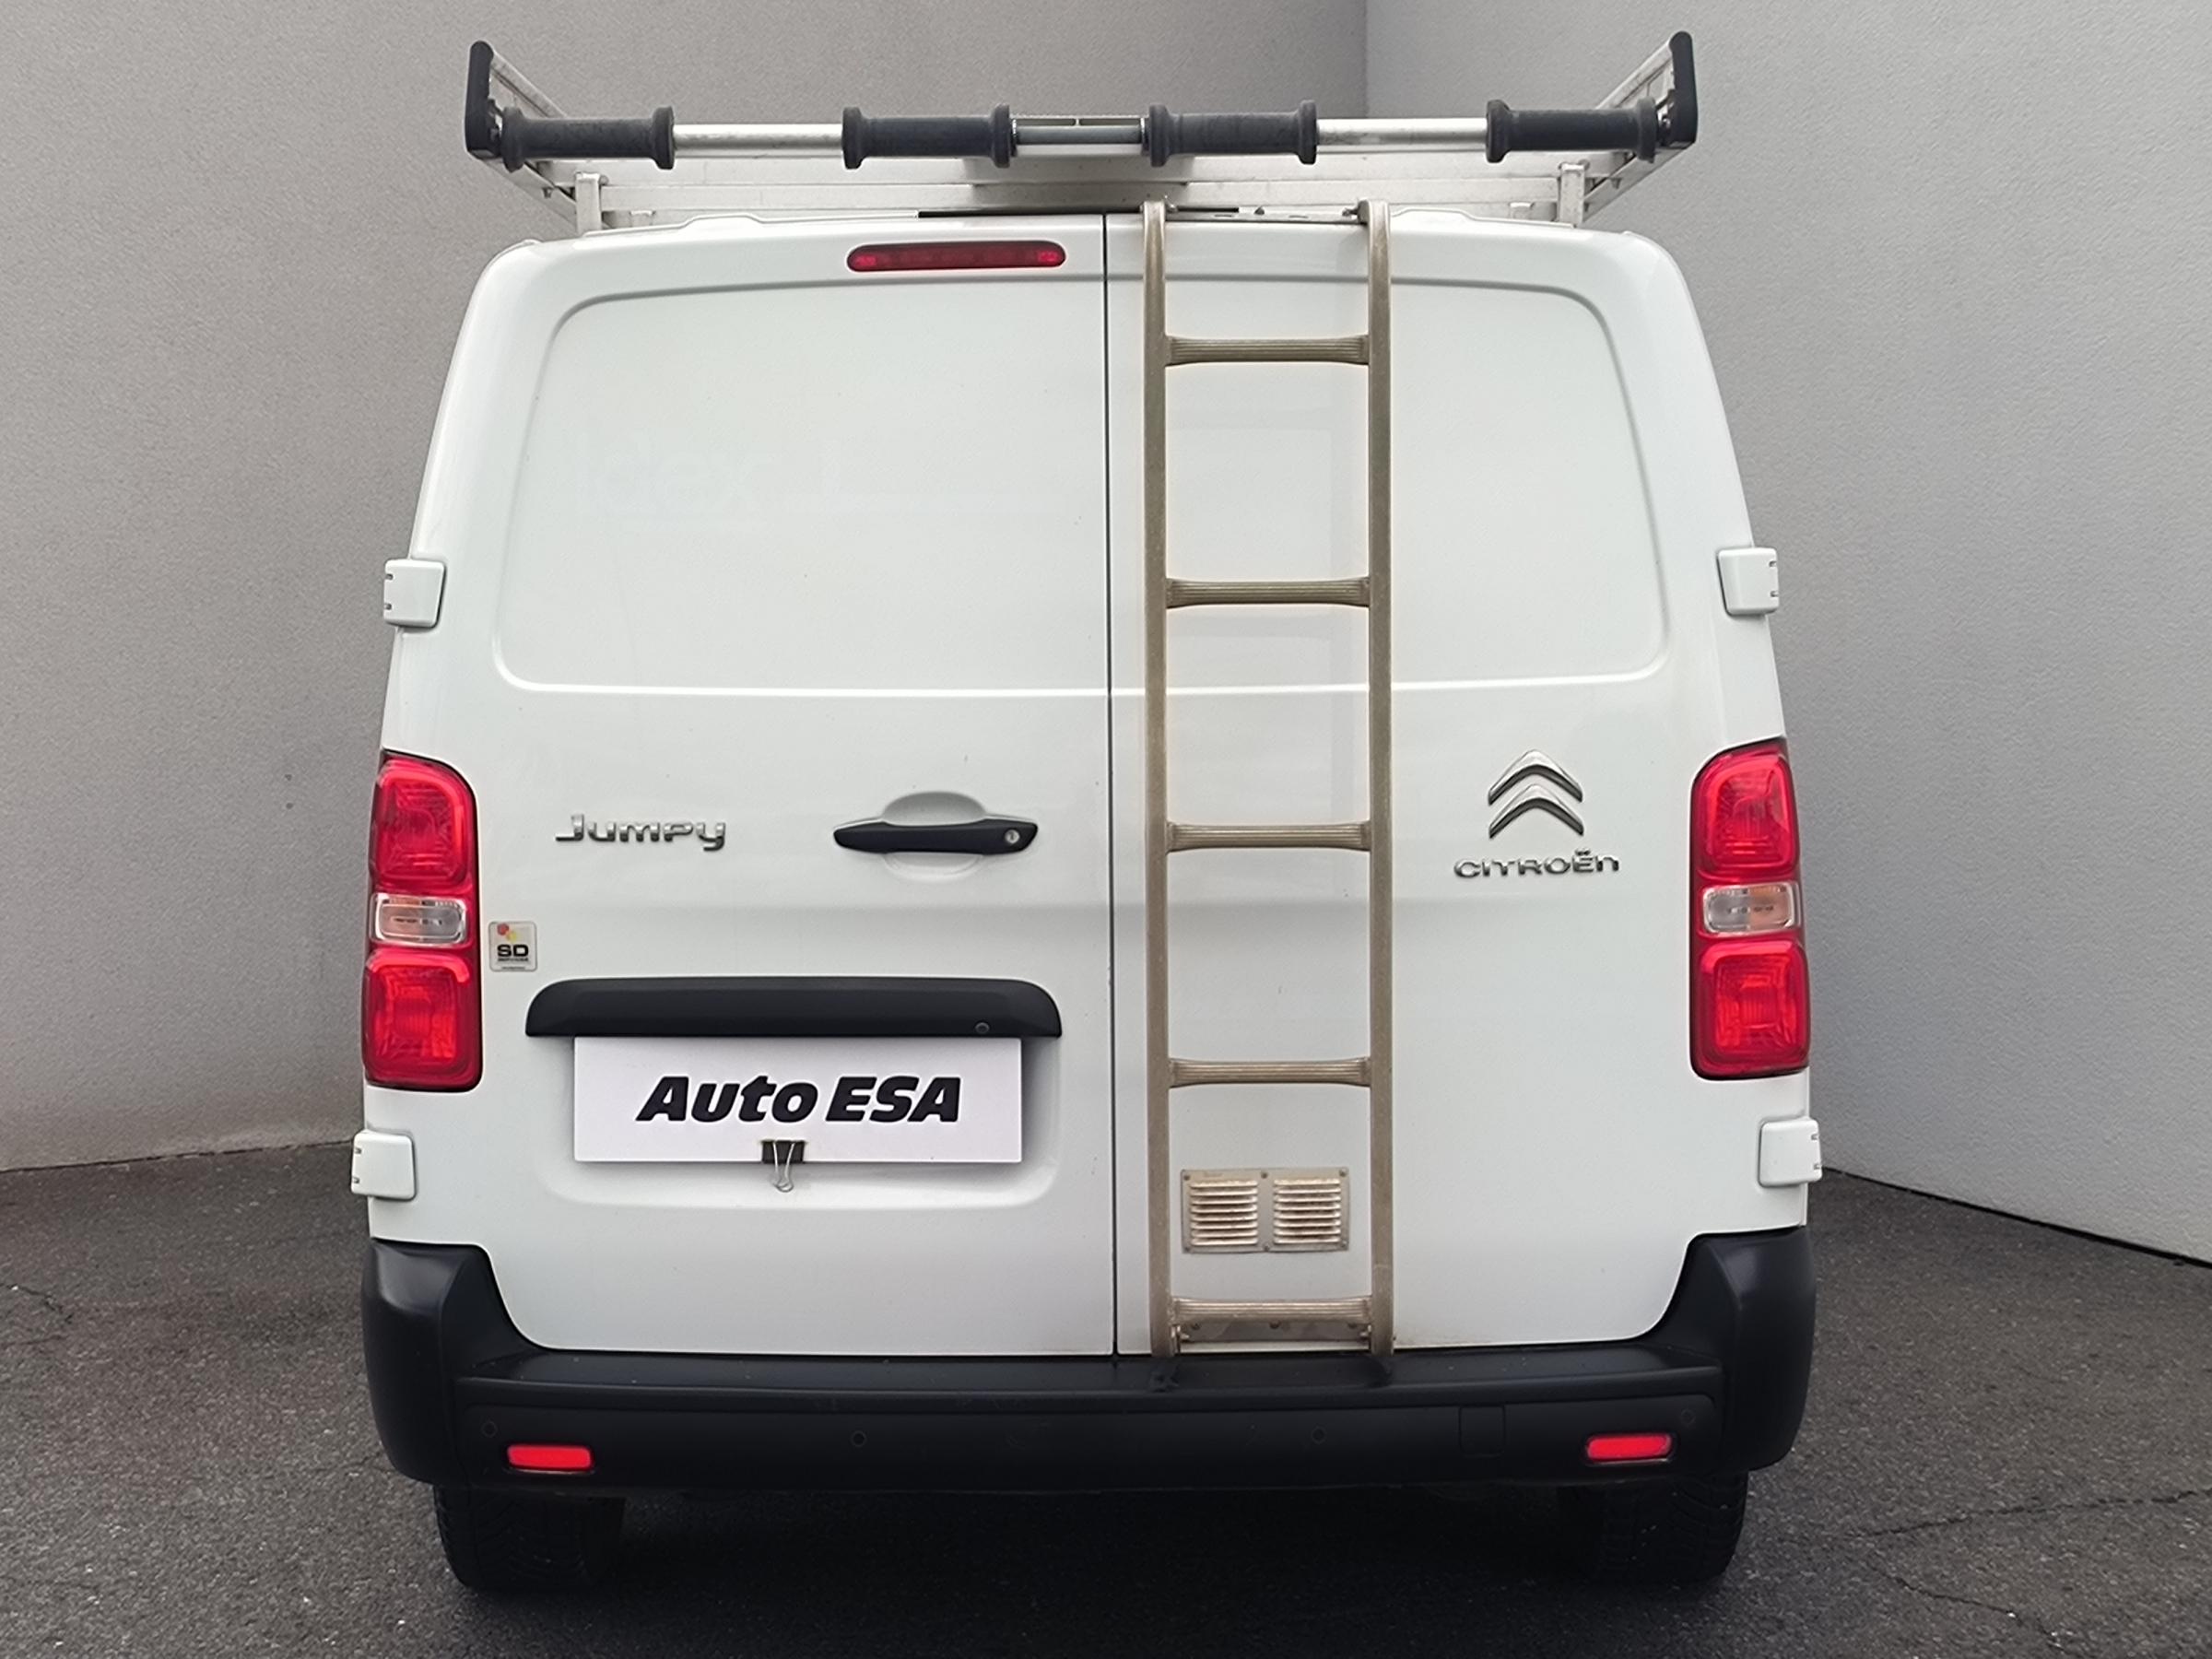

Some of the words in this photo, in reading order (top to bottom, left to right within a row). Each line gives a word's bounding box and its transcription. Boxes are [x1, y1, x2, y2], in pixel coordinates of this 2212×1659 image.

[555, 814, 726, 852] Jumpy
[497, 944, 529, 957] SD
[636, 1076, 818, 1123] Auto
[826, 1076, 960, 1123] ESA
